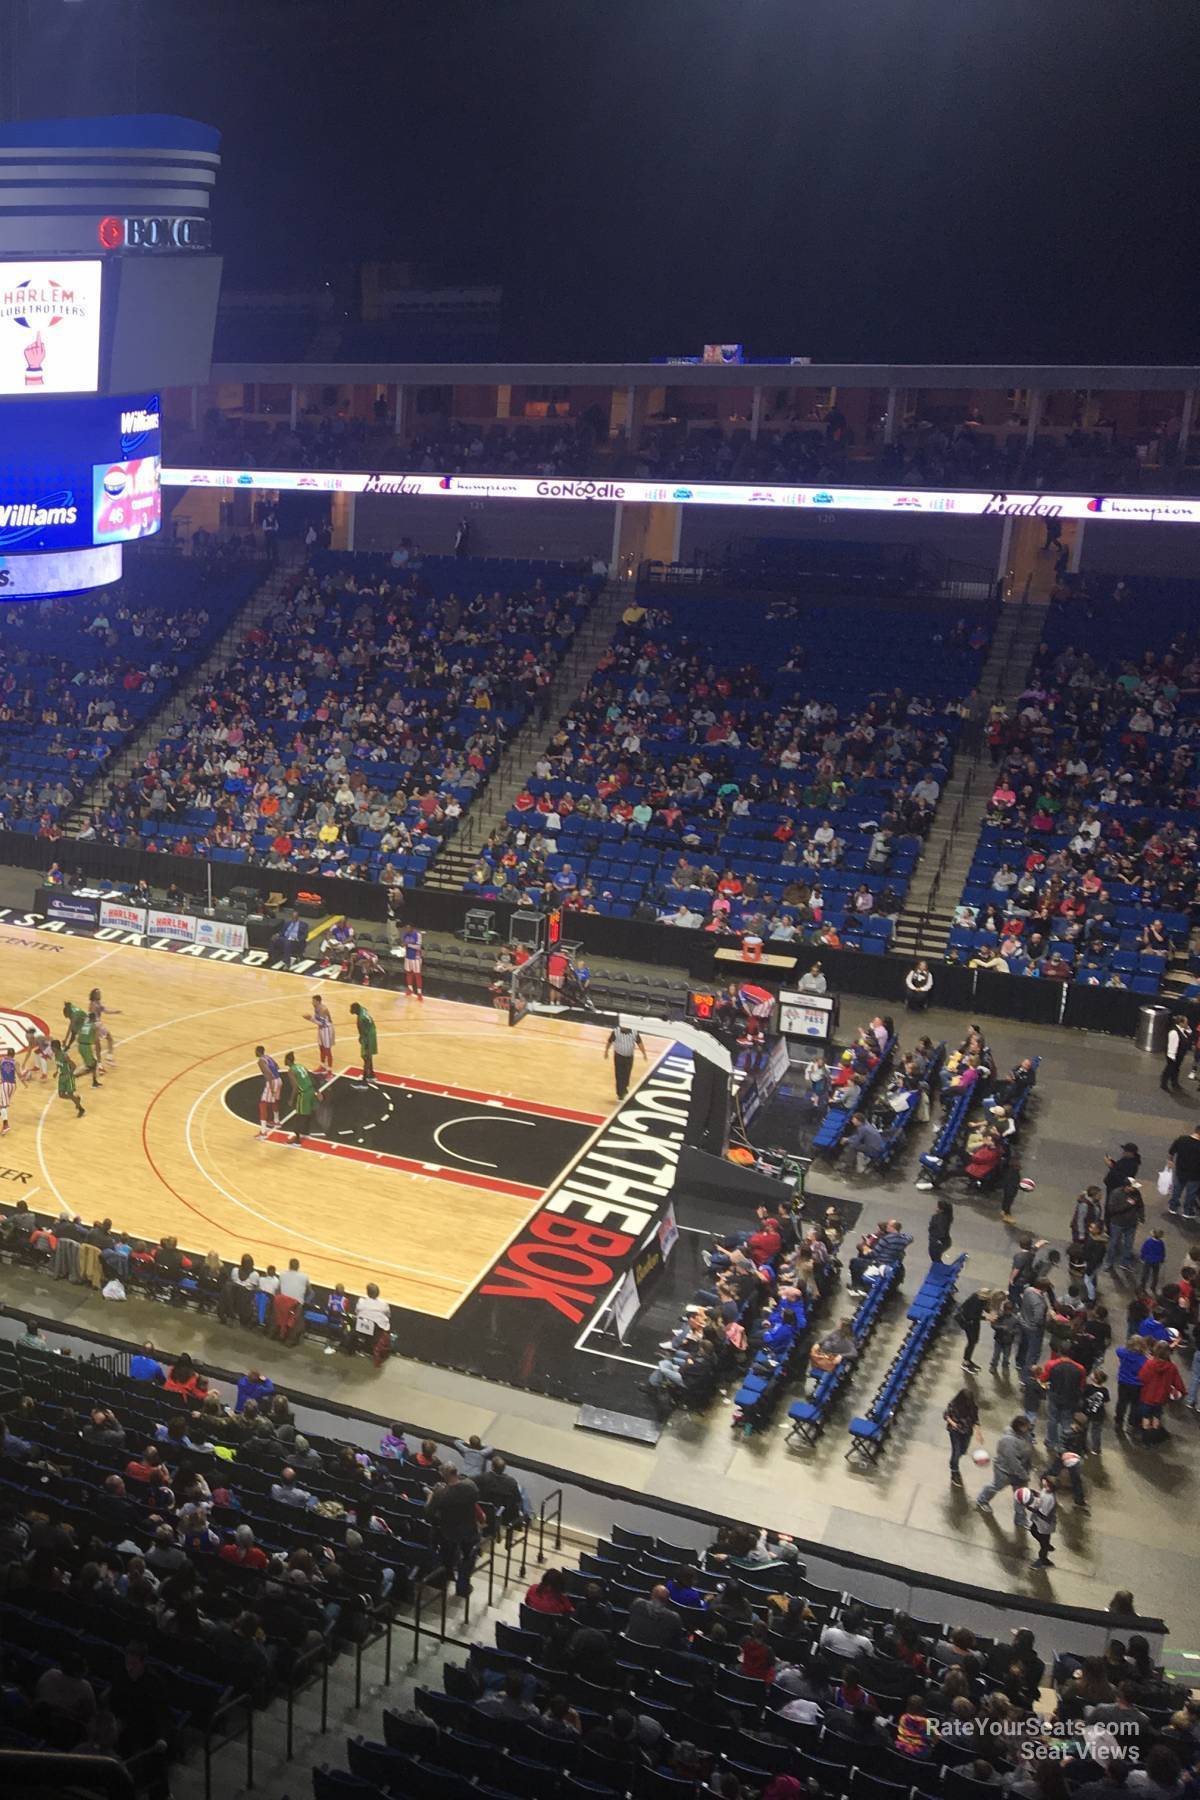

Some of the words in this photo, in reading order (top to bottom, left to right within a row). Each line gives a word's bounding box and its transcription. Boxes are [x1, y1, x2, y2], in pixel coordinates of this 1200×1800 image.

[3, 287, 75, 305] HARLEM
[363, 473, 424, 495] Baden
[982, 493, 1064, 517] Baden
[52, 899, 92, 913] Champion
[108, 908, 140, 923] HARLEM
[156, 917, 189, 930] HARLEM
